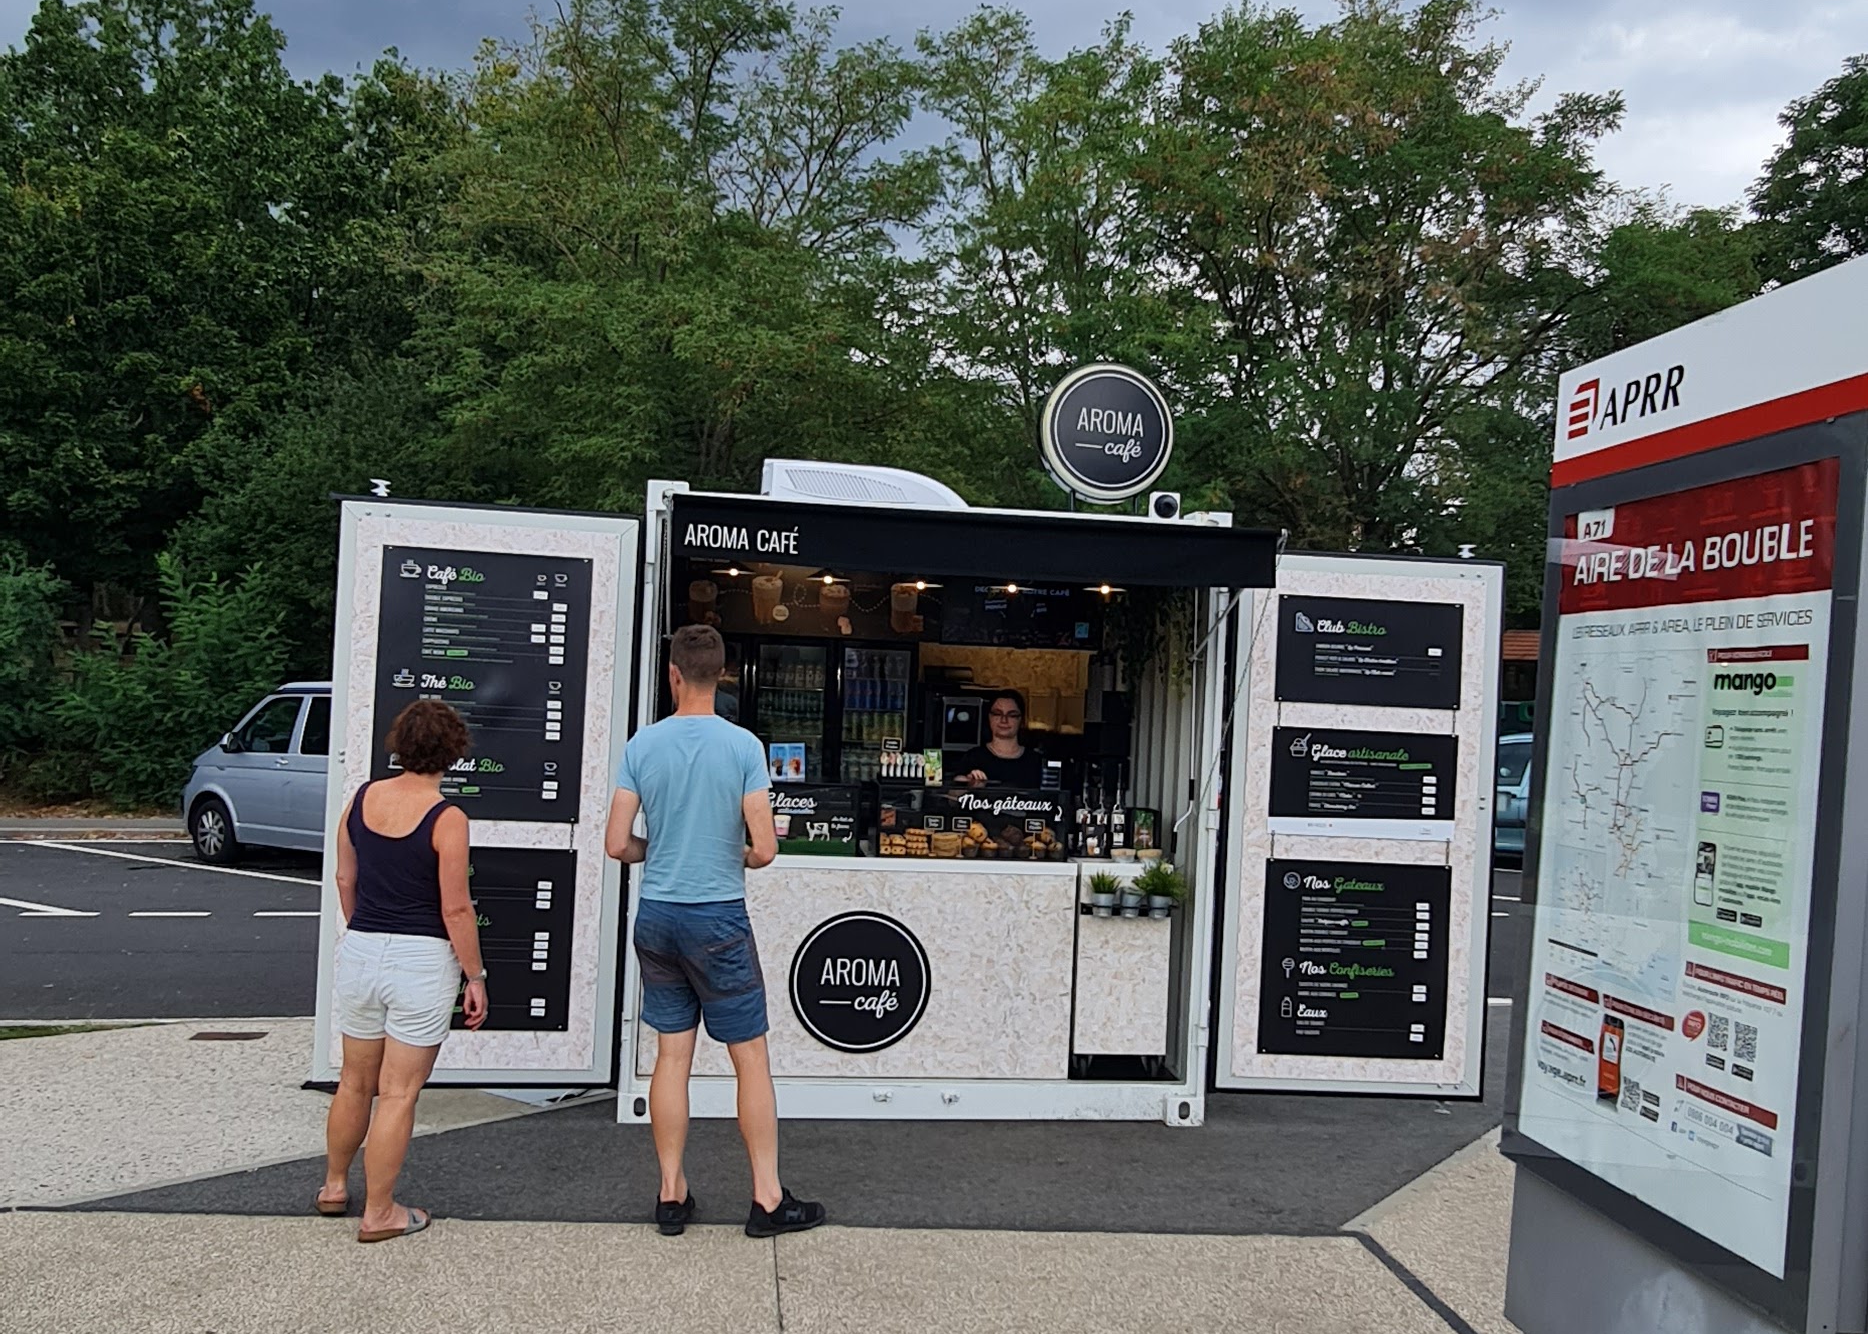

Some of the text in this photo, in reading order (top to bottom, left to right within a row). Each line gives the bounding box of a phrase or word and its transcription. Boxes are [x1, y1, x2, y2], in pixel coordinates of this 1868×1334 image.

[1599, 364, 1684, 431] APRR
[1076, 407, 1144, 438] AROMA
[1104, 438, 1142, 463] café
[684, 523, 799, 554] AROMA CAFÉ
[1583, 520, 1606, 538] A71
[1573, 519, 1814, 586] AIRE DE LA BOUBLE
[427, 565, 485, 584] Café Bio
[1317, 619, 1387, 636] Club Bistro
[1736, 613, 1754, 630] DE
[1756, 609, 1813, 629] SERVICES
[420, 673, 475, 691] Thé Bio
[1713, 672, 1777, 696] mango
[1311, 743, 1410, 762] Glace artisanale
[478, 758, 505, 773] Bio
[958, 793, 1053, 816] Nos gâteaux
[1303, 876, 1331, 890] Nos
[820, 958, 900, 987] AROMA
[1299, 961, 1395, 980] Nos Confiseries
[854, 989, 899, 1019] café
[1296, 1004, 1328, 1018] Eaux
